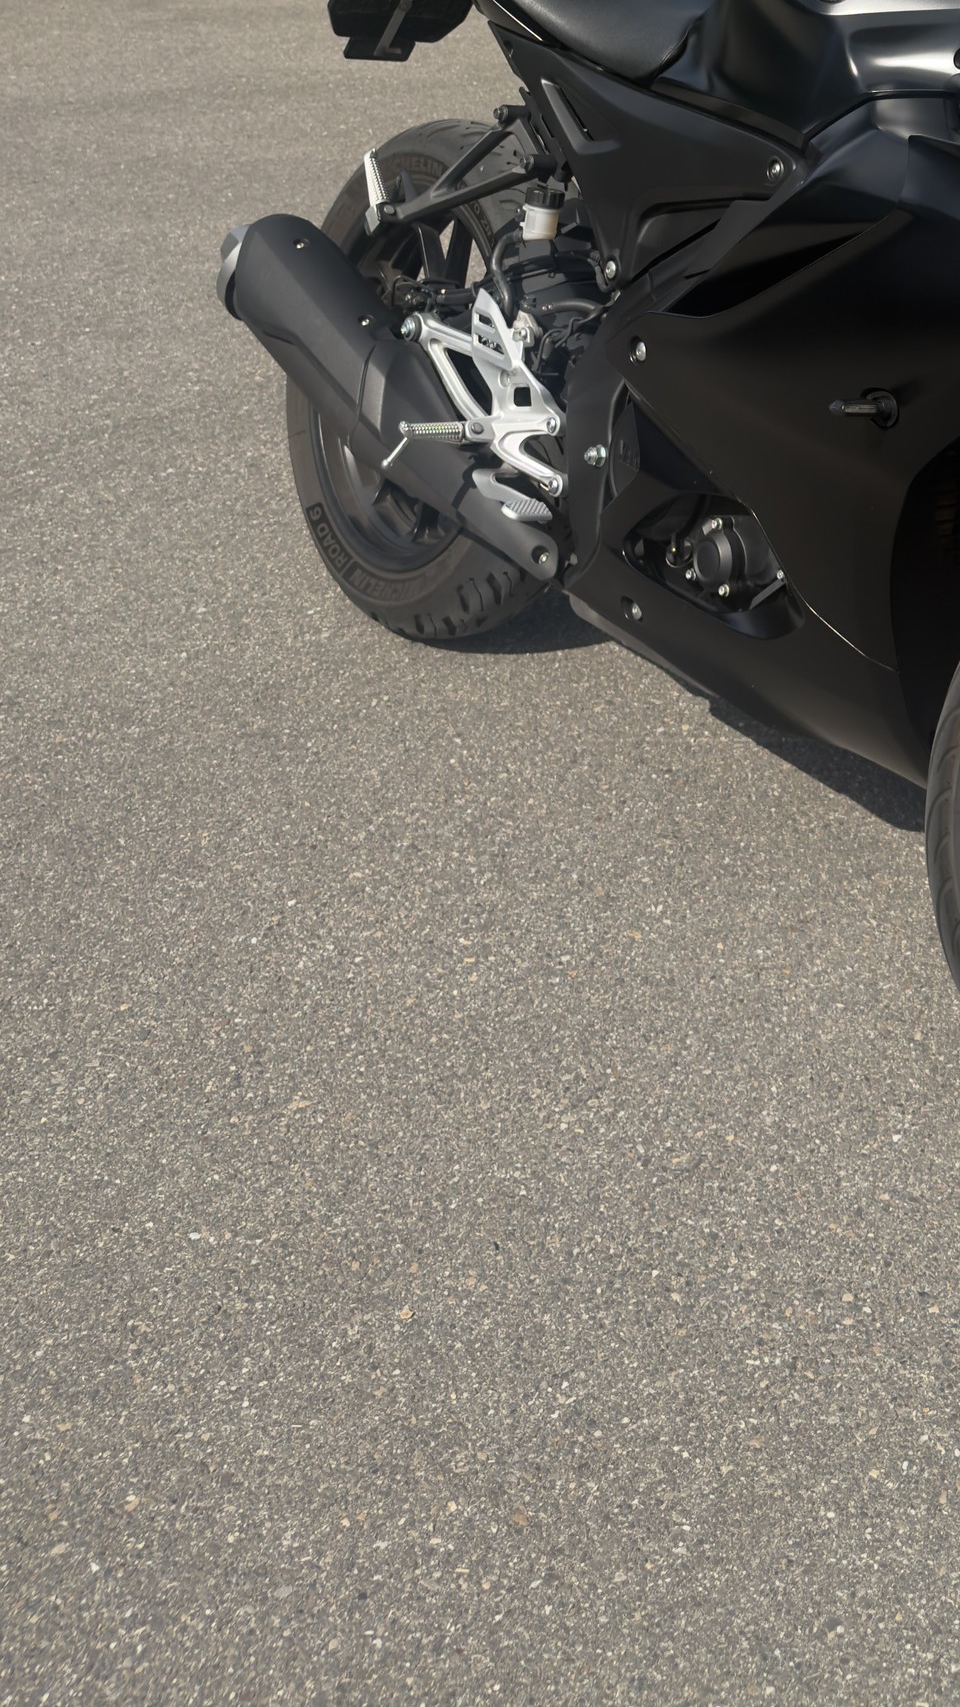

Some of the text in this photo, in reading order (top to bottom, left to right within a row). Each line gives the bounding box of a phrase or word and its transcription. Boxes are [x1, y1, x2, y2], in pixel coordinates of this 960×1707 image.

[386, 155, 444, 179] ICHELIN
[308, 505, 348, 567] ROAD 6
